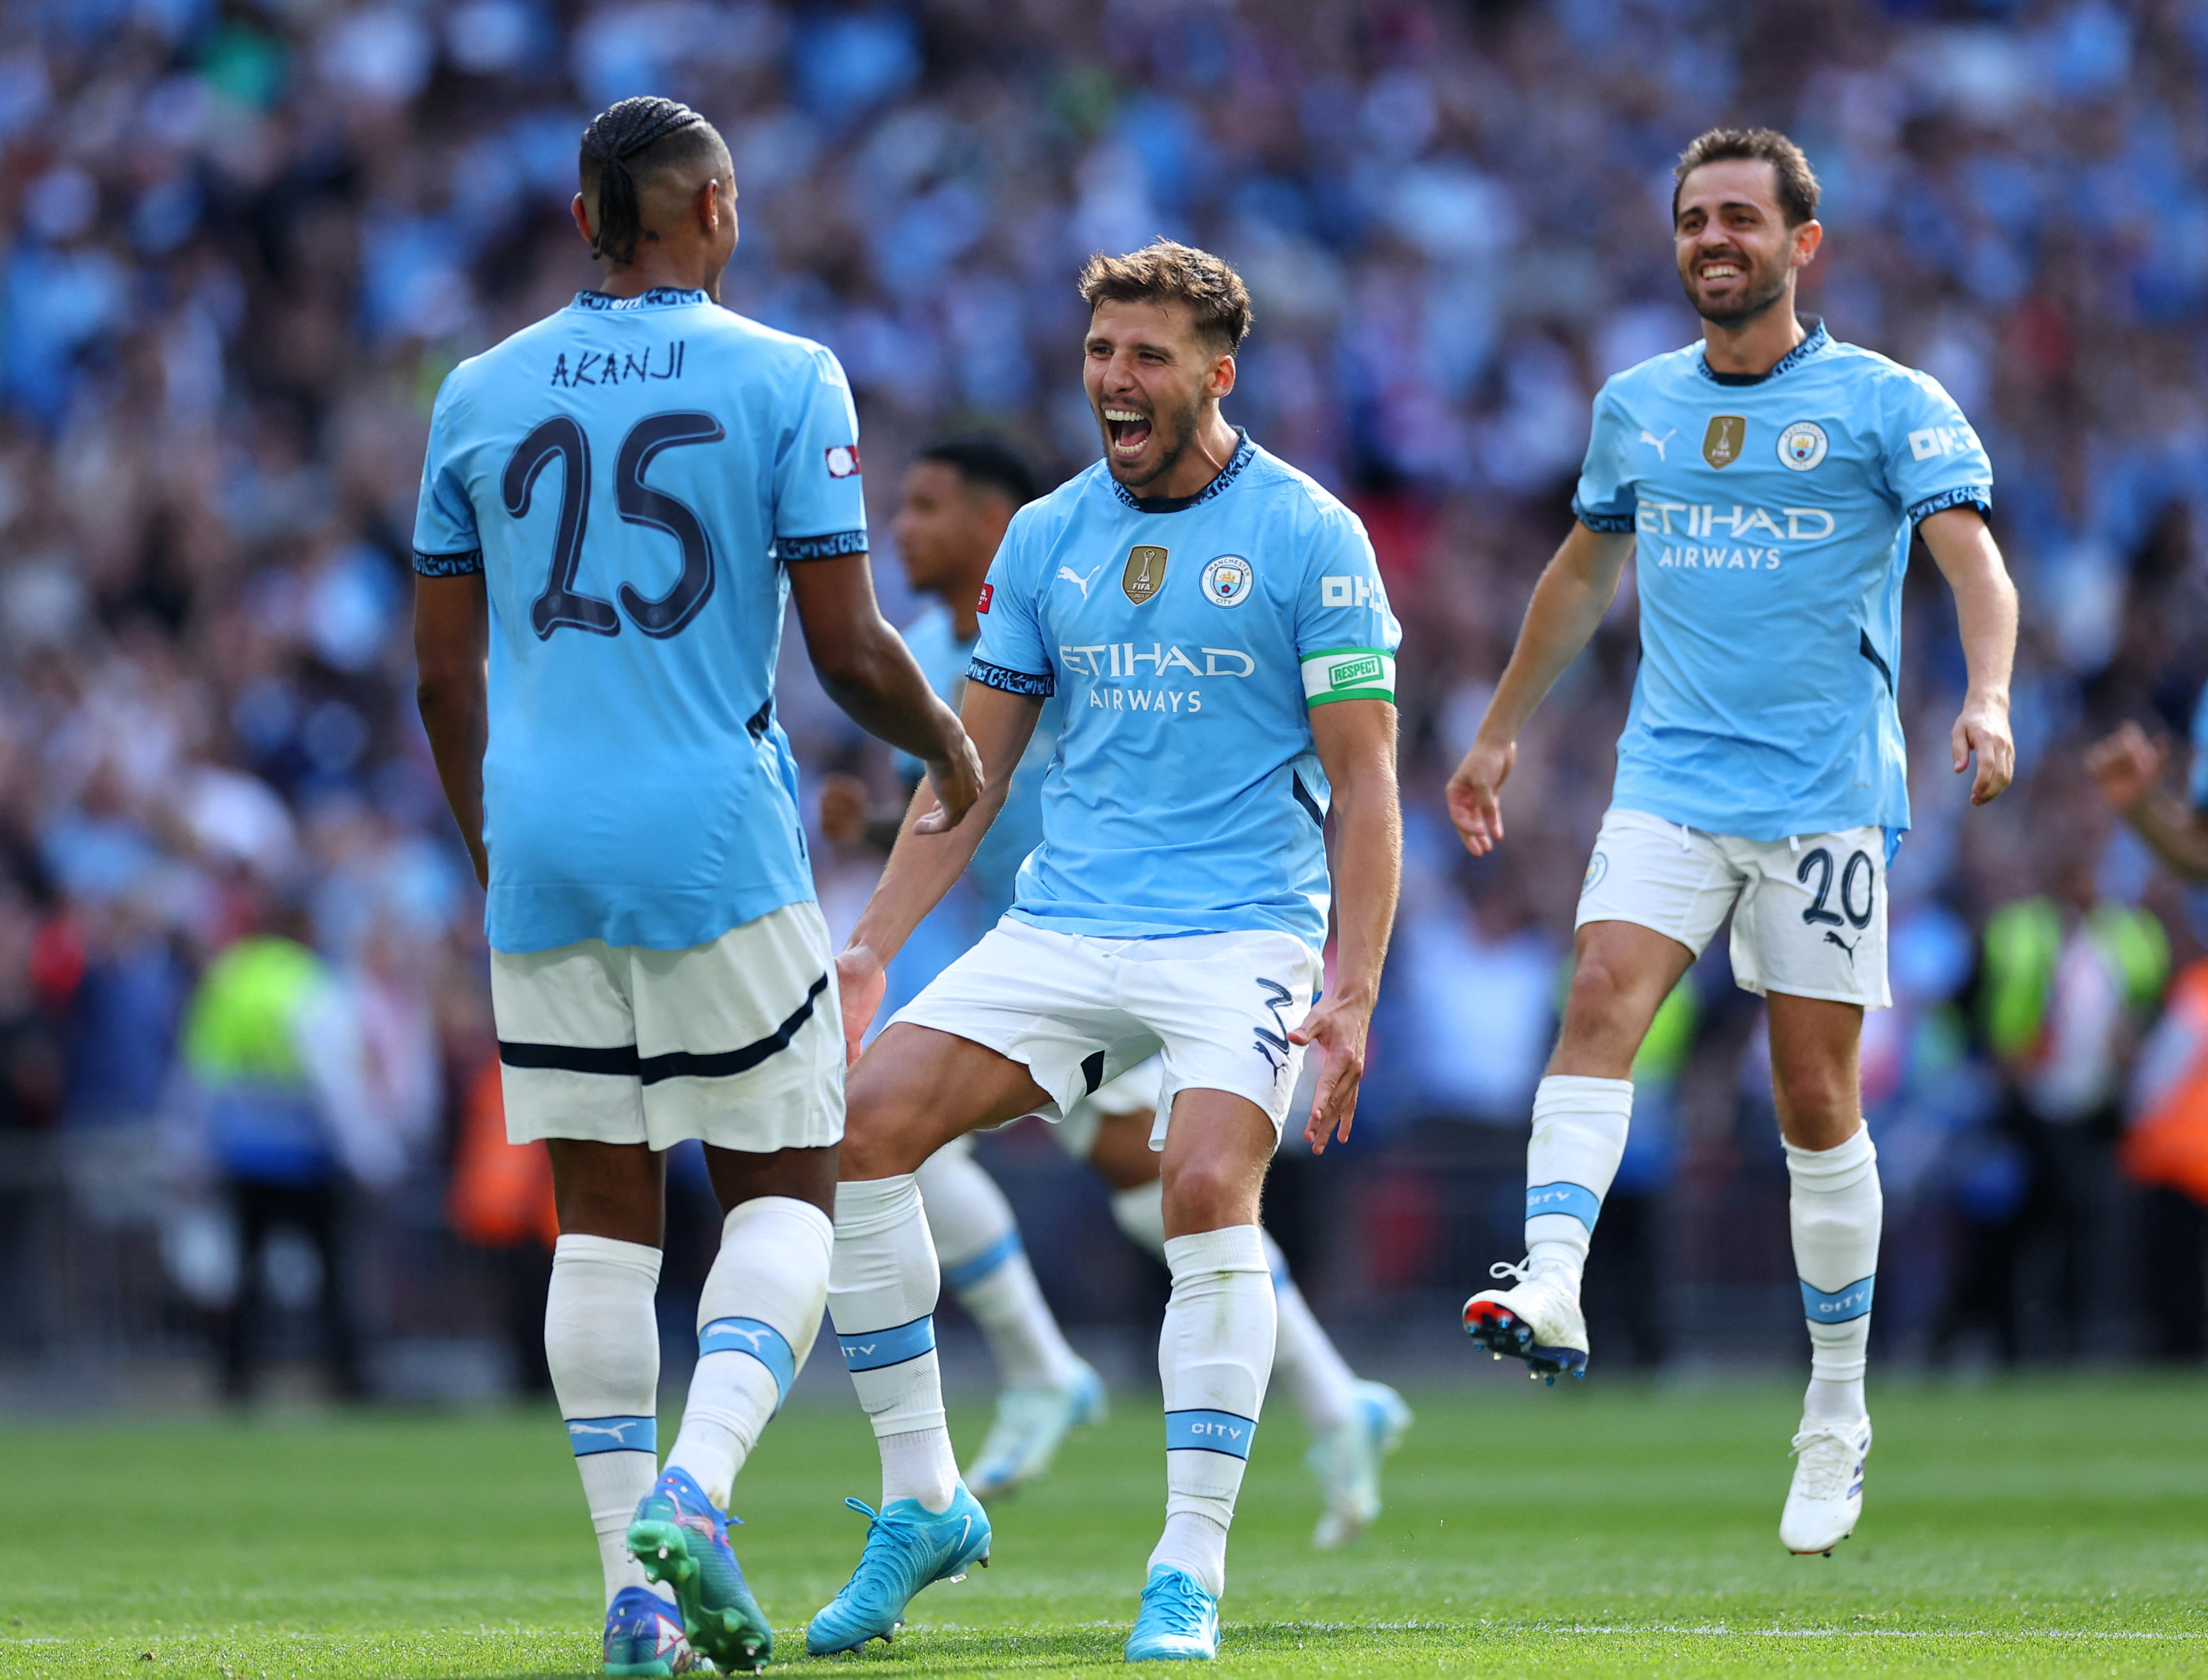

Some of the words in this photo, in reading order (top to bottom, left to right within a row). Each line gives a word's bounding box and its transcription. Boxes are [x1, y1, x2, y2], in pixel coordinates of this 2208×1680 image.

[551, 341, 684, 388] AKANJI
[501, 410, 725, 640] 25
[1638, 500, 1835, 540] ETIHAD
[1208, 559, 1250, 577] MANCHESTER
[1658, 546, 1781, 570] AIRWAYS
[1132, 582, 1150, 591] FIFA
[1059, 642, 1255, 678] ETIHAD
[1334, 660, 1376, 682] RESPECT
[1089, 688, 1201, 713] AIRWAYS
[1798, 848, 1874, 929] 20
[1820, 1291, 1864, 1313] CITY
[840, 1344, 876, 1357] ITY
[1191, 1423, 1242, 1440] CITY
